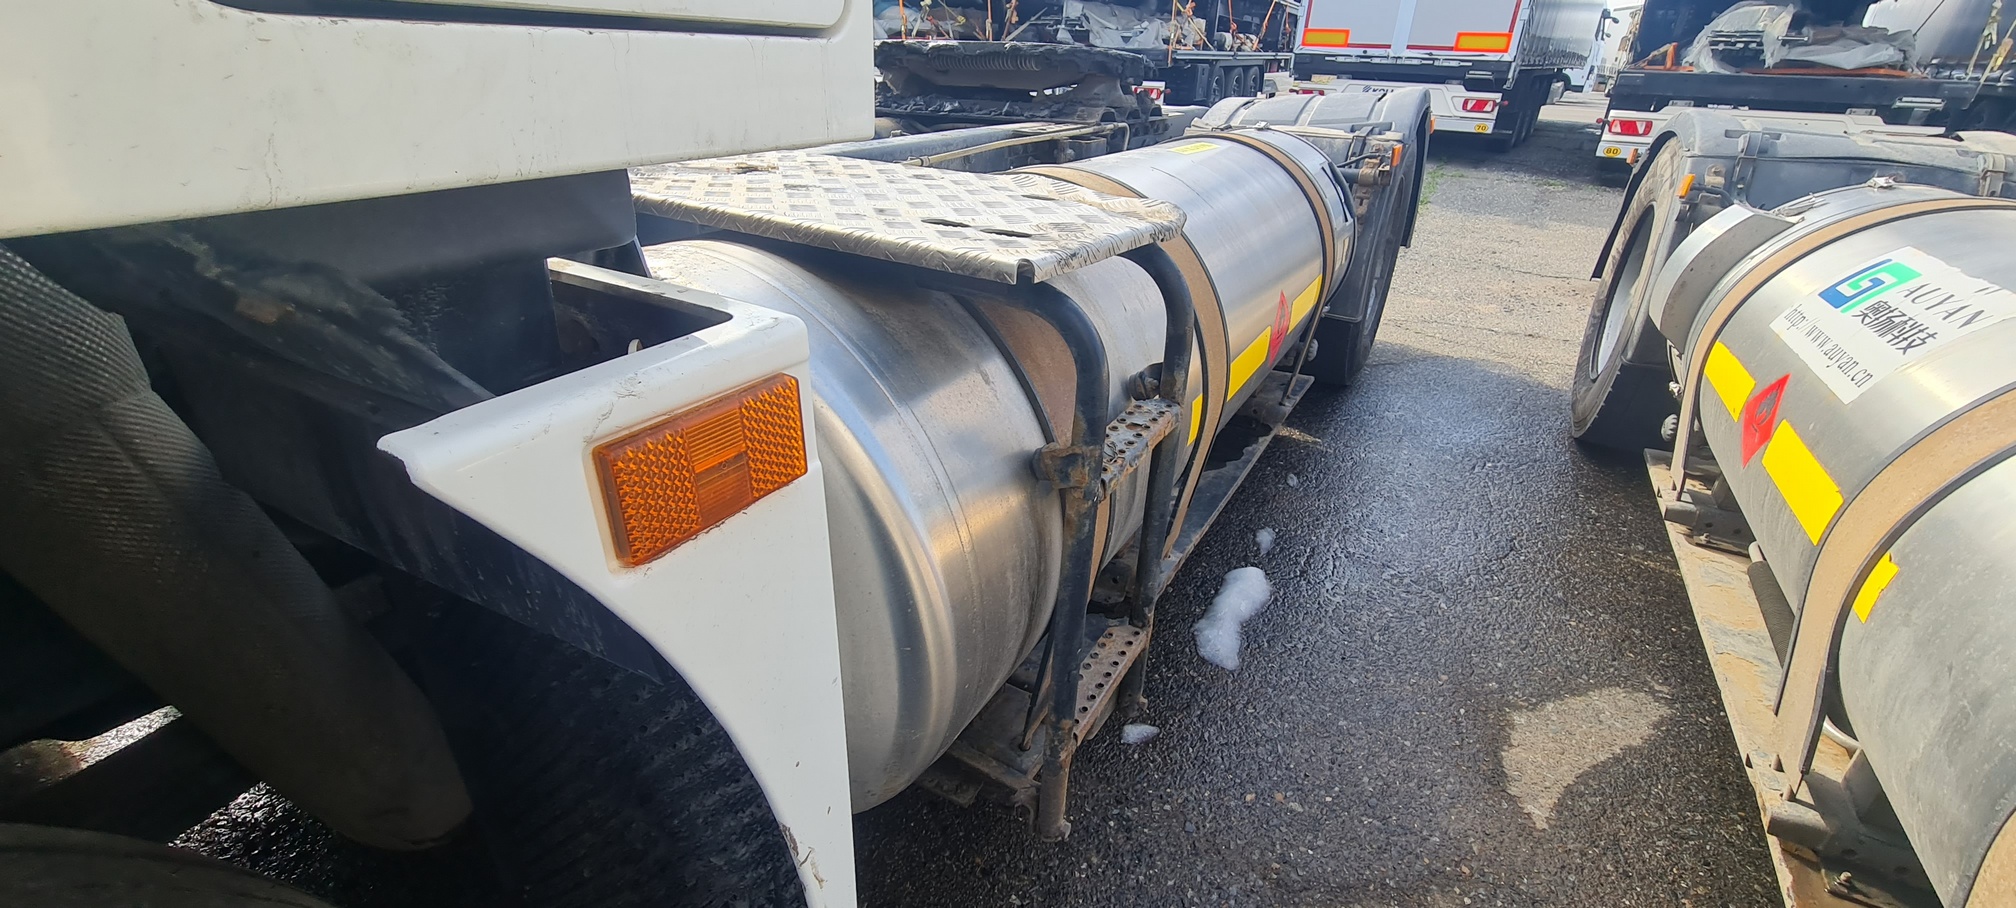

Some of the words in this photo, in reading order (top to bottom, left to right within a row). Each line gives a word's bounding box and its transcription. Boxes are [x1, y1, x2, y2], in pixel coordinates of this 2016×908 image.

[1605, 147, 1619, 155] 80
[1851, 300, 1938, 356] 奥扬科技
[1896, 282, 1994, 329] AUYAN
[1784, 303, 1873, 388] http://www.auyan.cn
